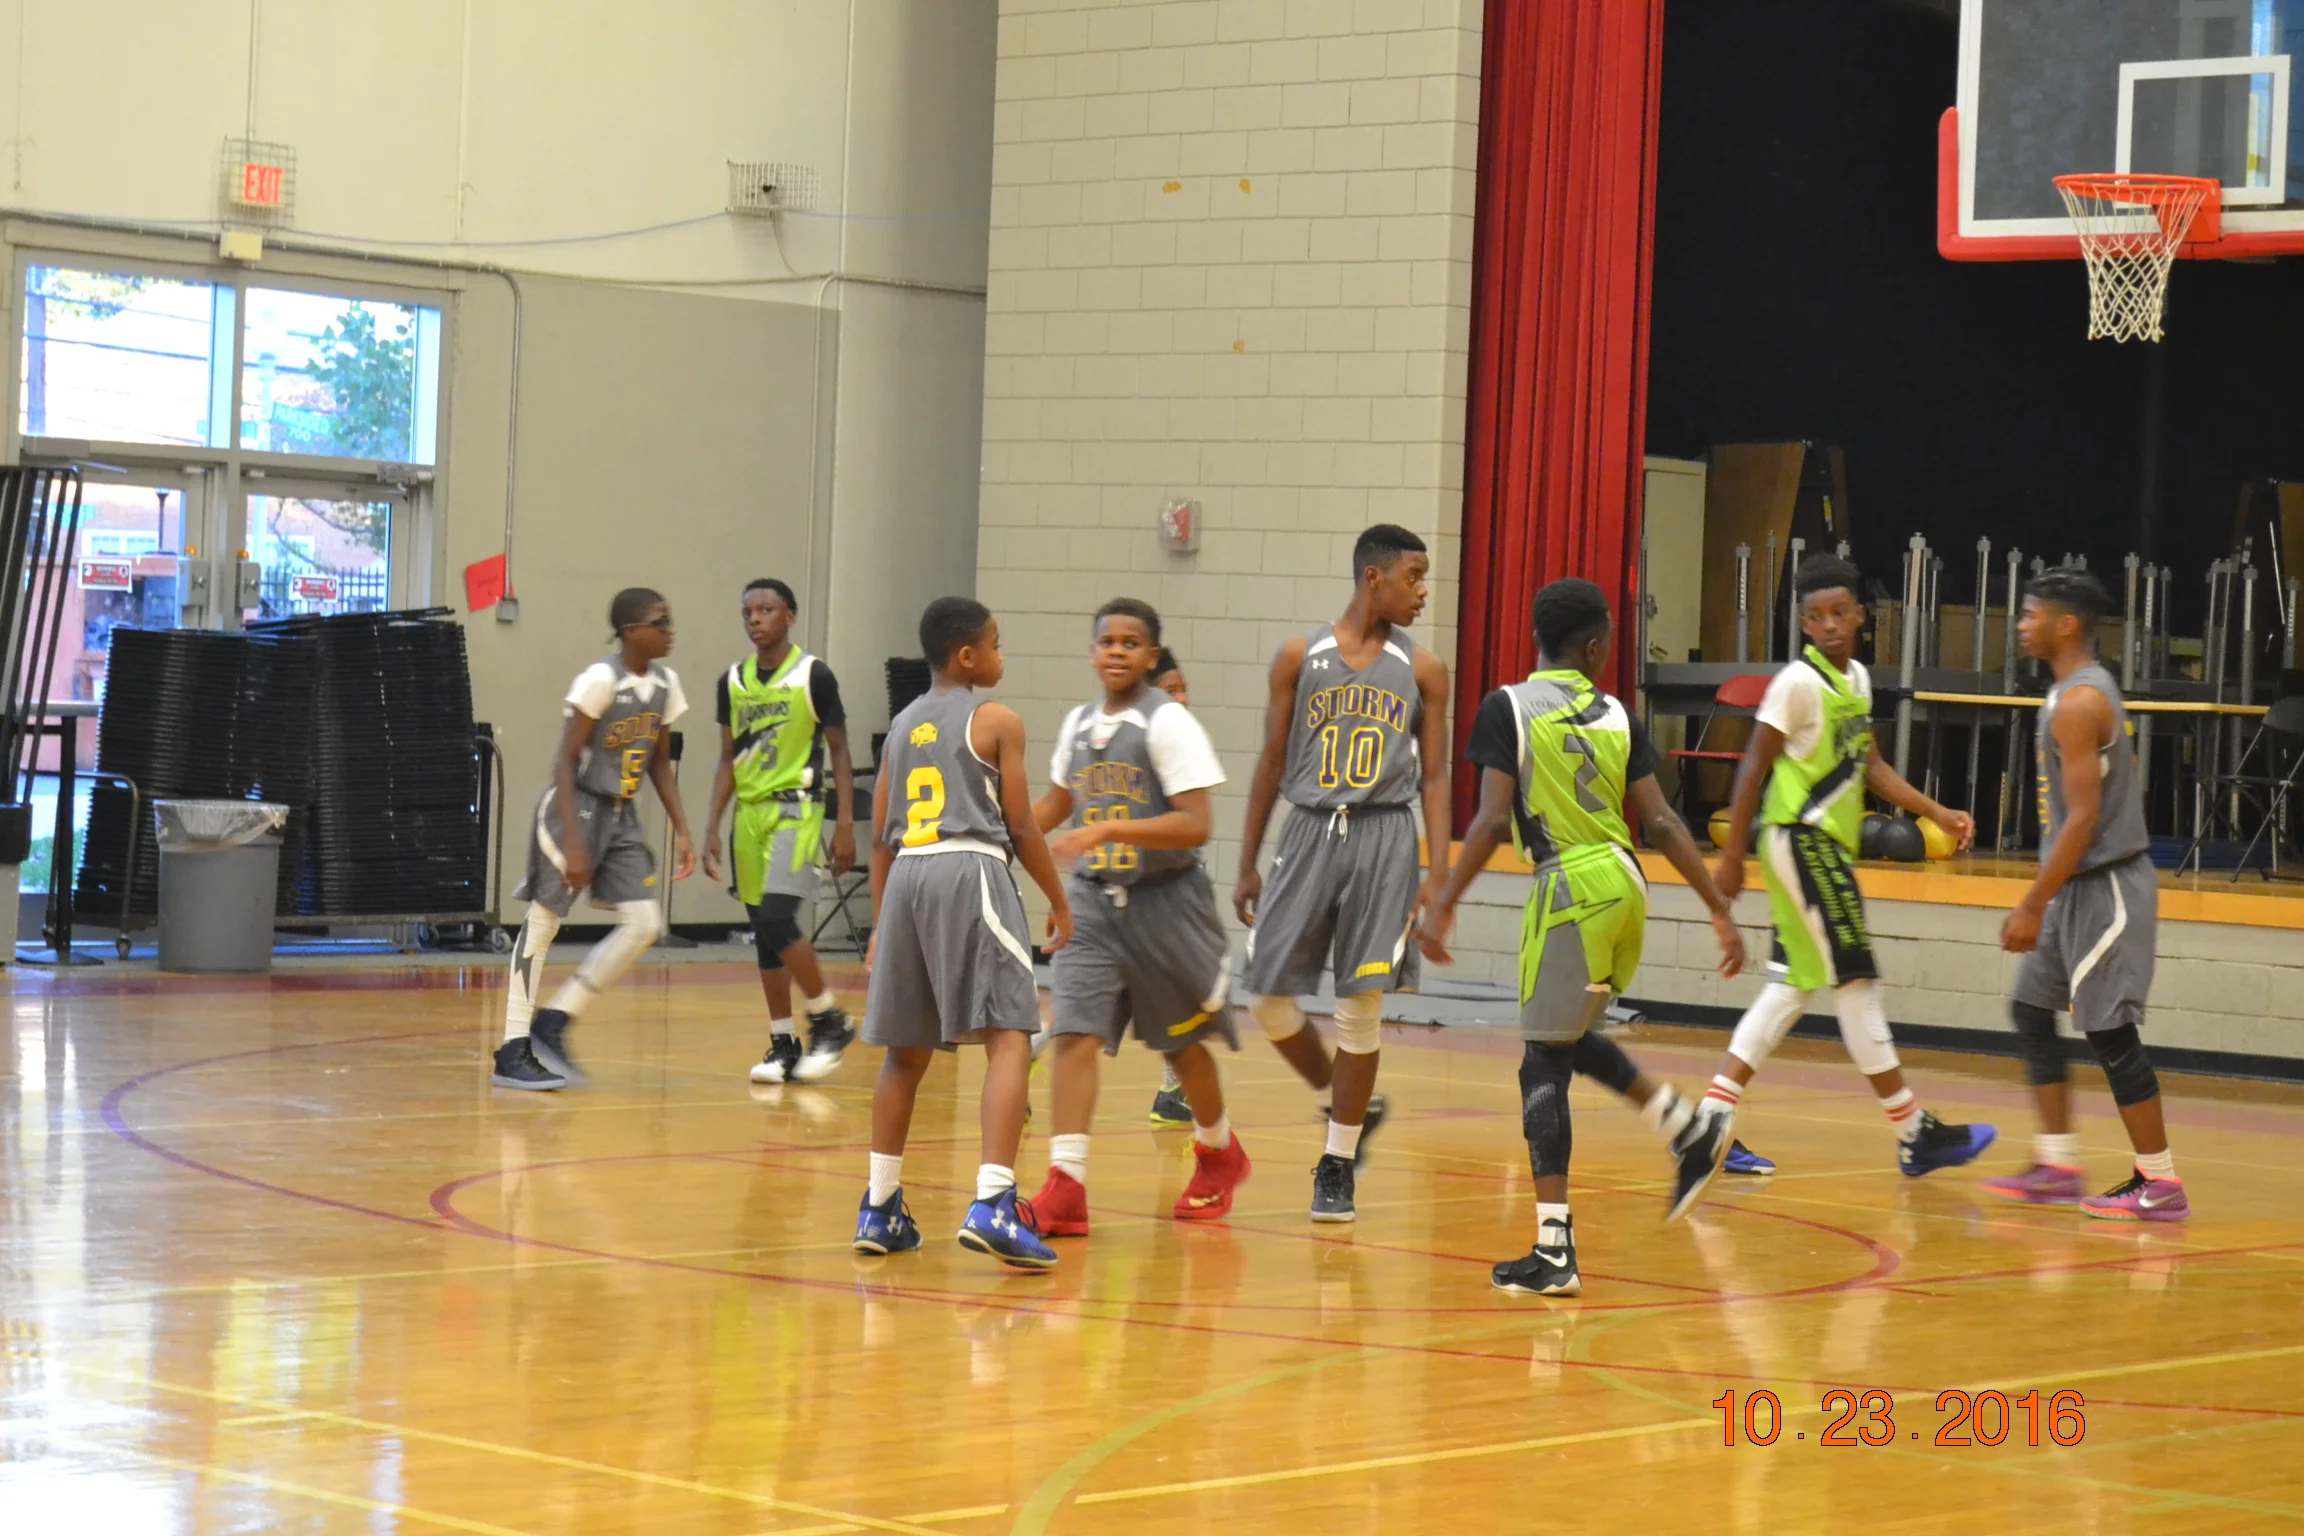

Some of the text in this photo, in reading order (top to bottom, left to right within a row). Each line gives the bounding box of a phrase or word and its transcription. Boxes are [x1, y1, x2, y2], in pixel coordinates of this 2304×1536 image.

[244, 163, 285, 205] EXIT
[1307, 684, 1407, 732] STORM
[1319, 725, 1384, 788] 10
[902, 765, 945, 848] 2
